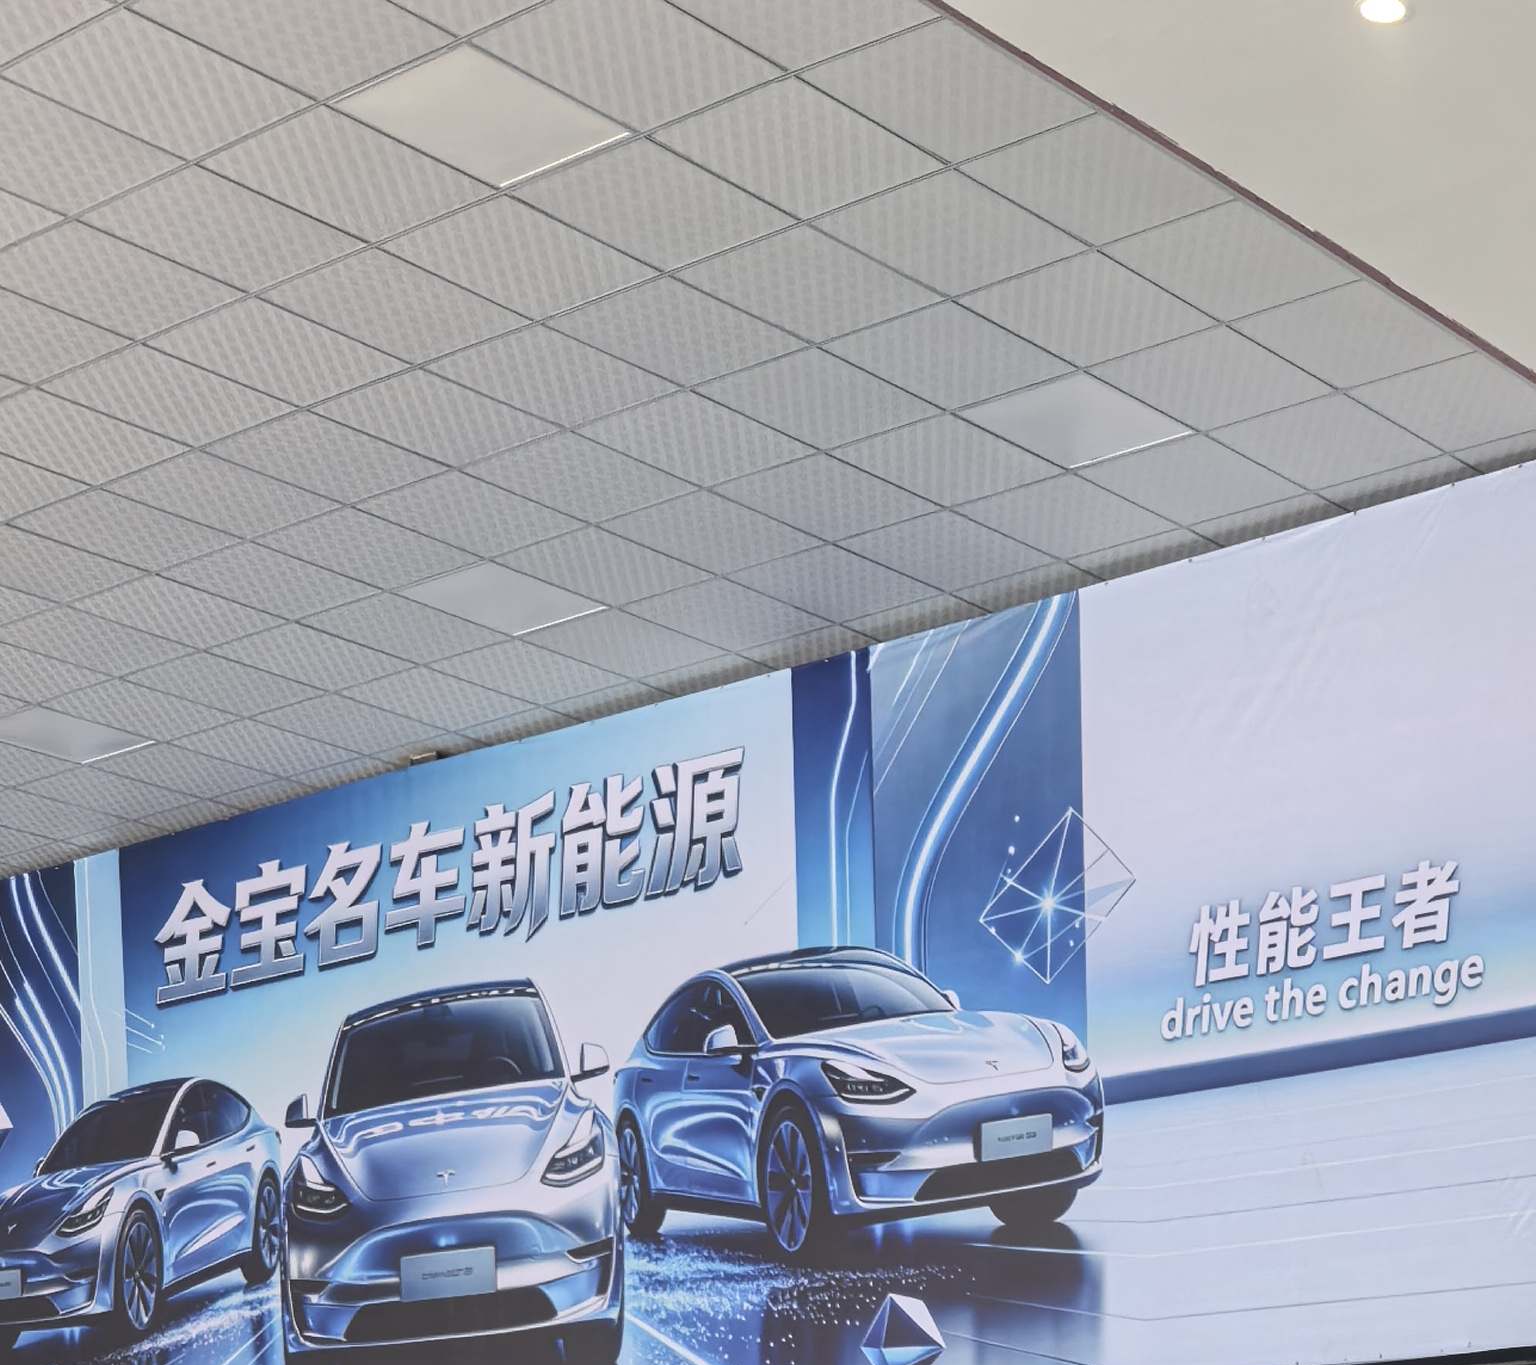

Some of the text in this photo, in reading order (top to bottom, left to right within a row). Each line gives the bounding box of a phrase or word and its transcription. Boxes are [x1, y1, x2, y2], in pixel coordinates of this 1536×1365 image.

[155, 746, 744, 1008] 金宝名车新能源
[1188, 860, 1461, 988] 性能王者
[1160, 954, 1485, 1042] drive the change
